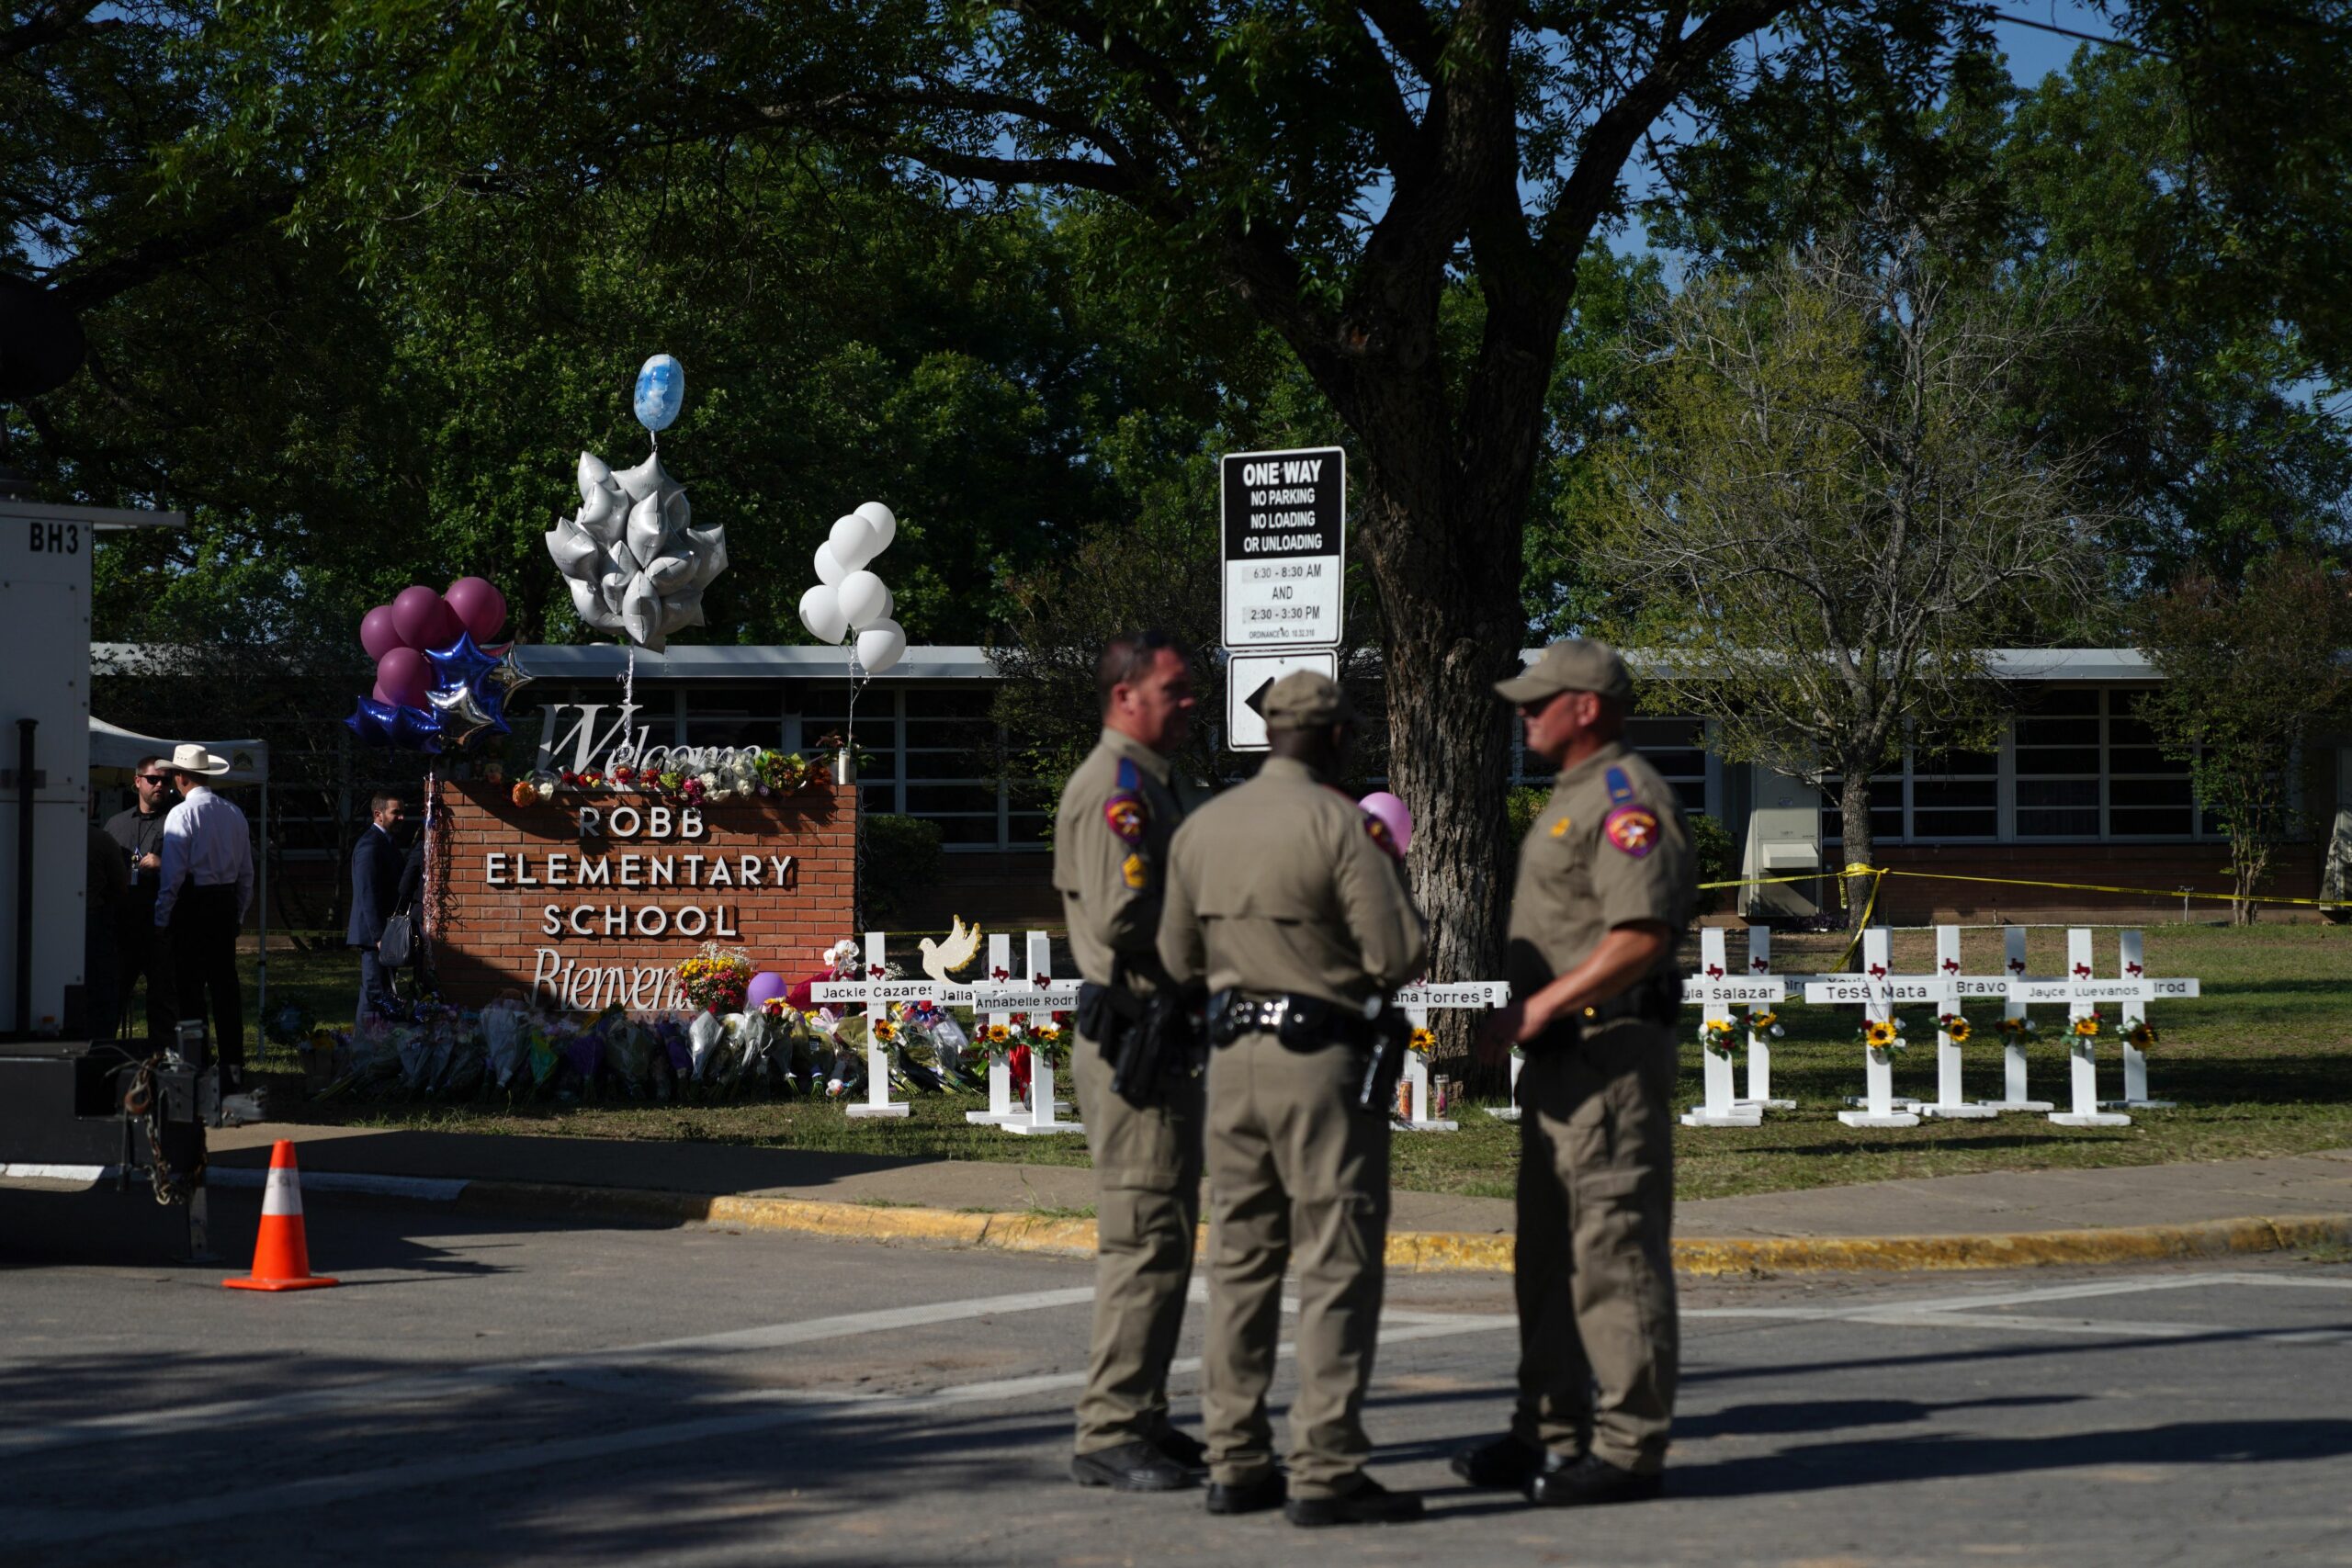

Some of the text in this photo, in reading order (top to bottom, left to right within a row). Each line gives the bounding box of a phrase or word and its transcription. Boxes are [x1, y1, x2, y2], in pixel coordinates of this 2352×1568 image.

[1243, 459, 1323, 487] ONE WAY
[1250, 488, 1316, 506] NO PARKING
[1250, 511, 1316, 529] NO LOADING
[29, 522, 79, 554] BH3
[1243, 533, 1323, 553] OR UNLOADING
[1253, 567, 1272, 579] 6:30
[1282, 566, 1303, 578] 8:30
[1306, 563, 1322, 578] AM
[1272, 585, 1294, 600] AND
[1250, 608, 1272, 620] 2:30
[1282, 607, 1303, 619] 3:30
[1306, 605, 1320, 619] PM
[1250, 631, 1280, 639] ORDINANCE
[579, 806, 705, 838] ROBB
[486, 852, 792, 886] ELEMENTARY
[542, 904, 737, 937] SCHOOL
[822, 987, 866, 999] Jackie
[1713, 987, 1777, 999] Salazar
[1826, 986, 1928, 999] Tess Mata
[1956, 981, 2007, 993] Bravo
[2029, 987, 2141, 999] Jayce Luevanos
[940, 989, 976, 1002] Jaila
[976, 996, 1041, 1009] Annabelle
[1423, 991, 1481, 1003] Torres
